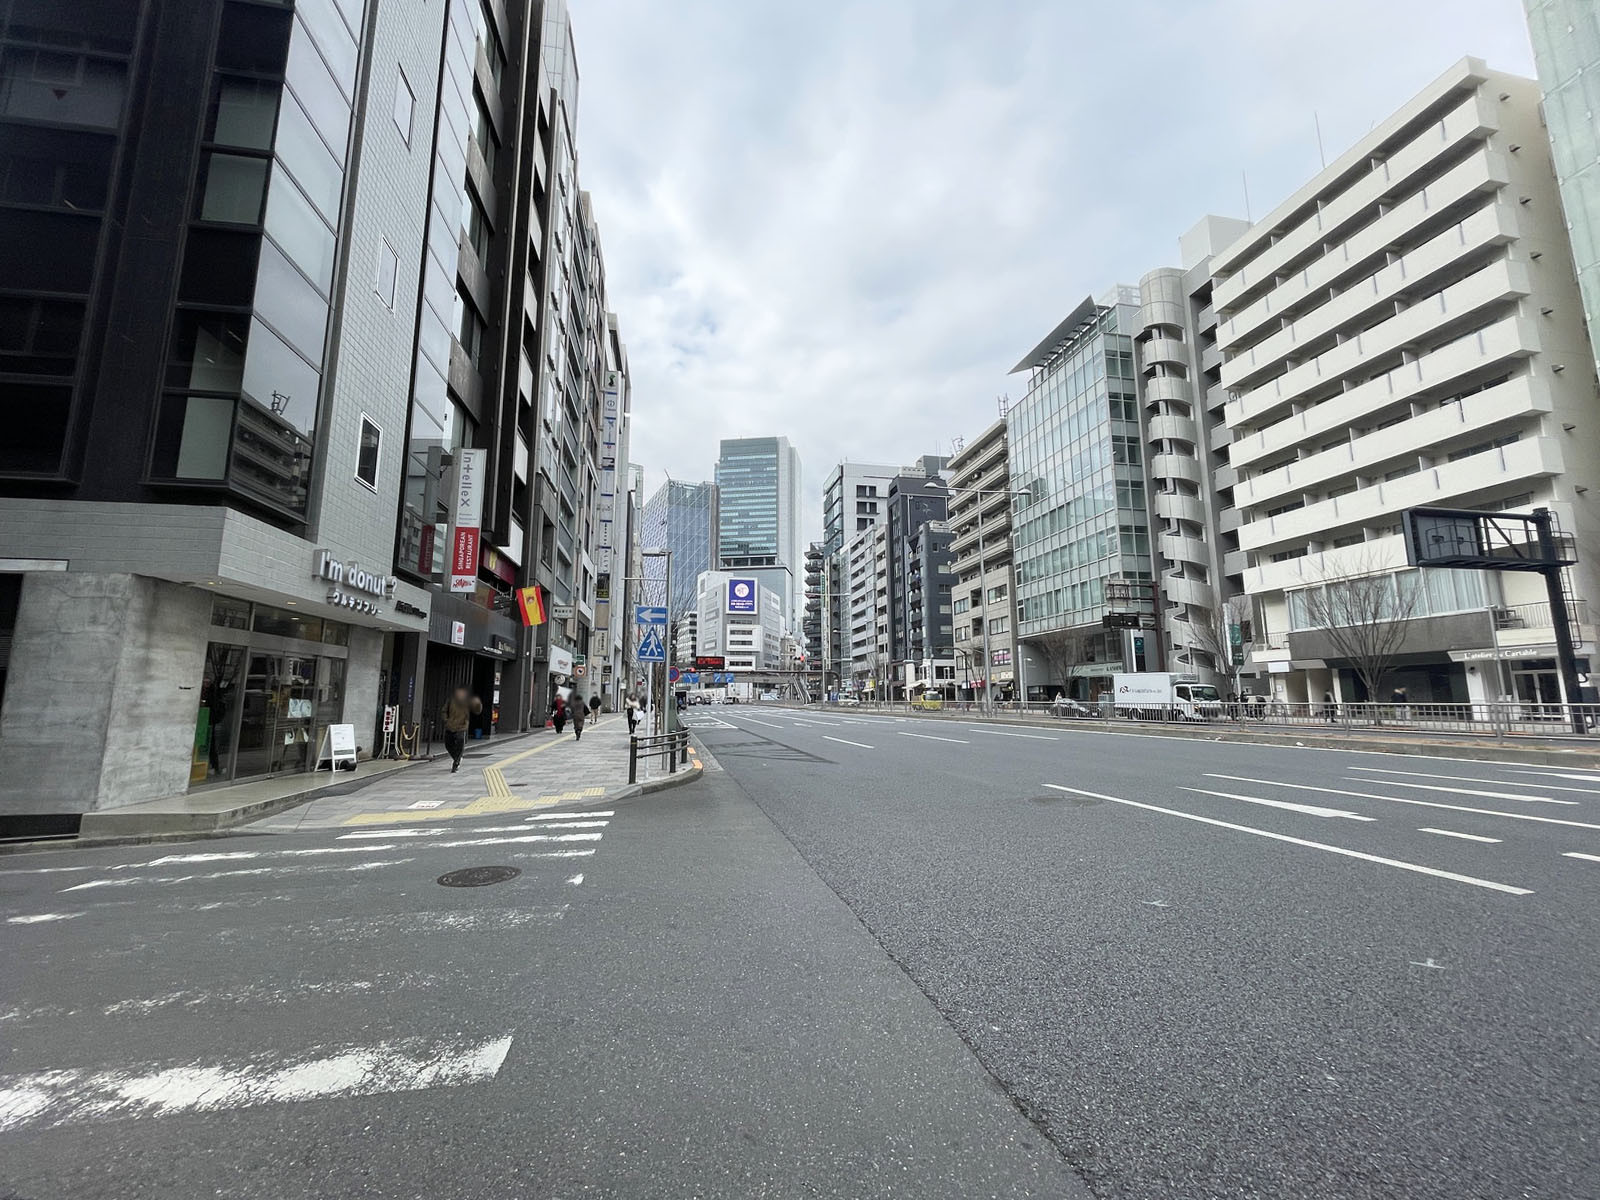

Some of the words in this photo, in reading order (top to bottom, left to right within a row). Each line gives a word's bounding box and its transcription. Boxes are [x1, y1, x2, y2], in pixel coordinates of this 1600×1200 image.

[457, 531, 466, 570] SINGAPOREAN
[465, 534, 473, 569] RESTAURANT
[320, 551, 343, 582] I'm
[348, 563, 386, 596] donut
